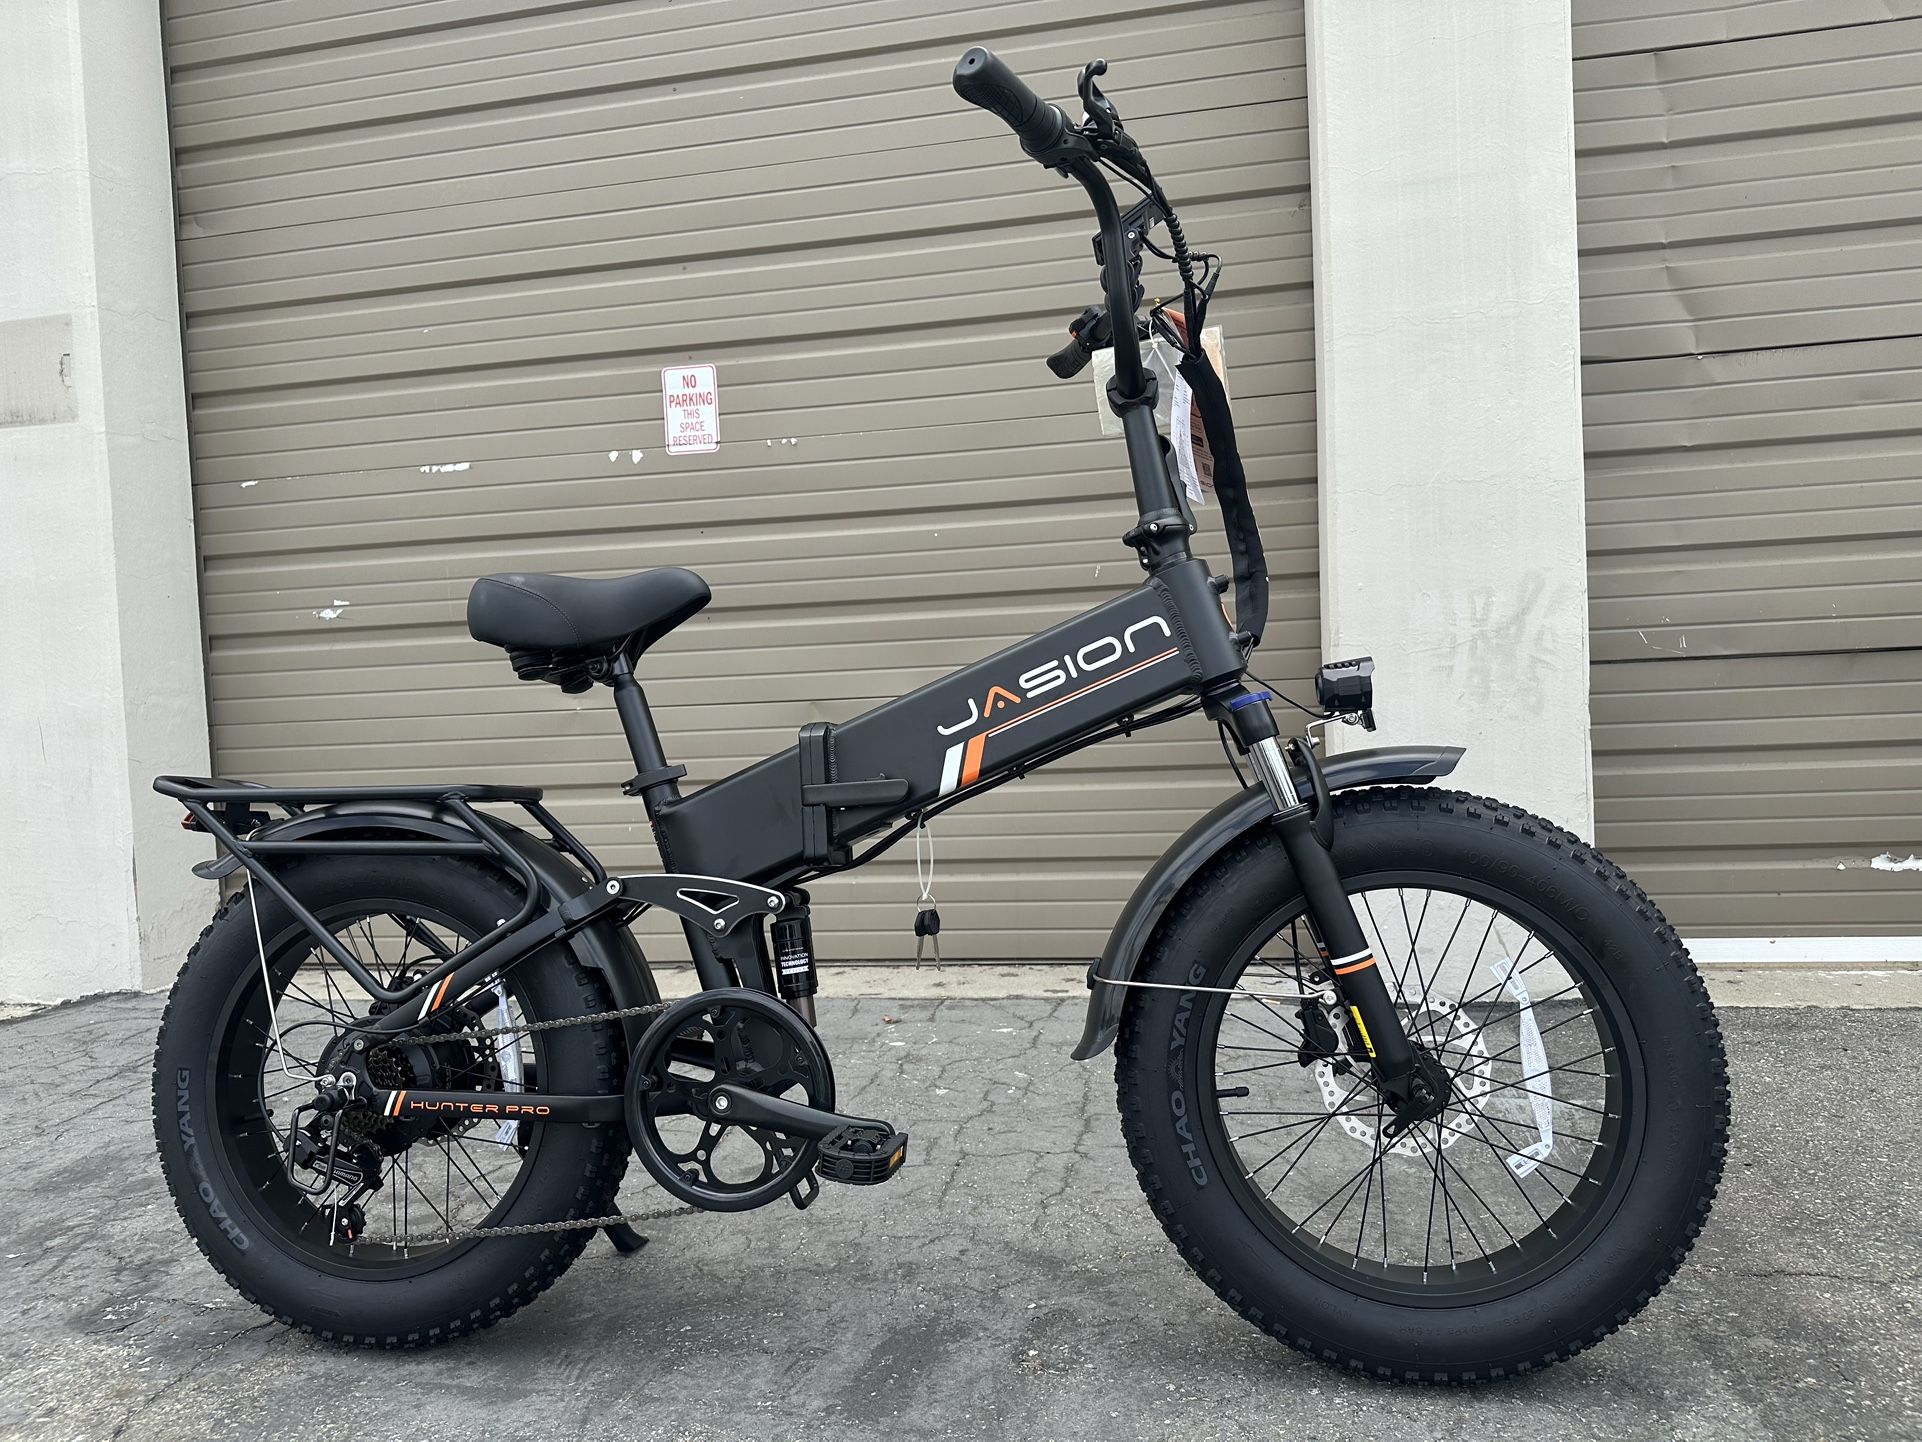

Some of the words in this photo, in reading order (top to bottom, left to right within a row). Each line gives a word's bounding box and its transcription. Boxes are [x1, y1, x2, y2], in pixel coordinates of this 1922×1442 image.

[682, 374, 697, 389] NO
[669, 391, 713, 408] PARKING
[682, 408, 701, 420] THIS
[679, 421, 705, 433] SPACE
[672, 433, 714, 447] RESERVED
[936, 615, 1172, 736] JASION
[780, 957, 809, 968] TECHNOLOGY
[1170, 962, 1208, 1051] YANG
[176, 1068, 197, 1153] YANG
[410, 1100, 499, 1114] HUNTER
[505, 1105, 551, 1115] PRO
[1170, 1089, 1209, 1187] CHAO
[198, 1181, 250, 1251] CHAO
